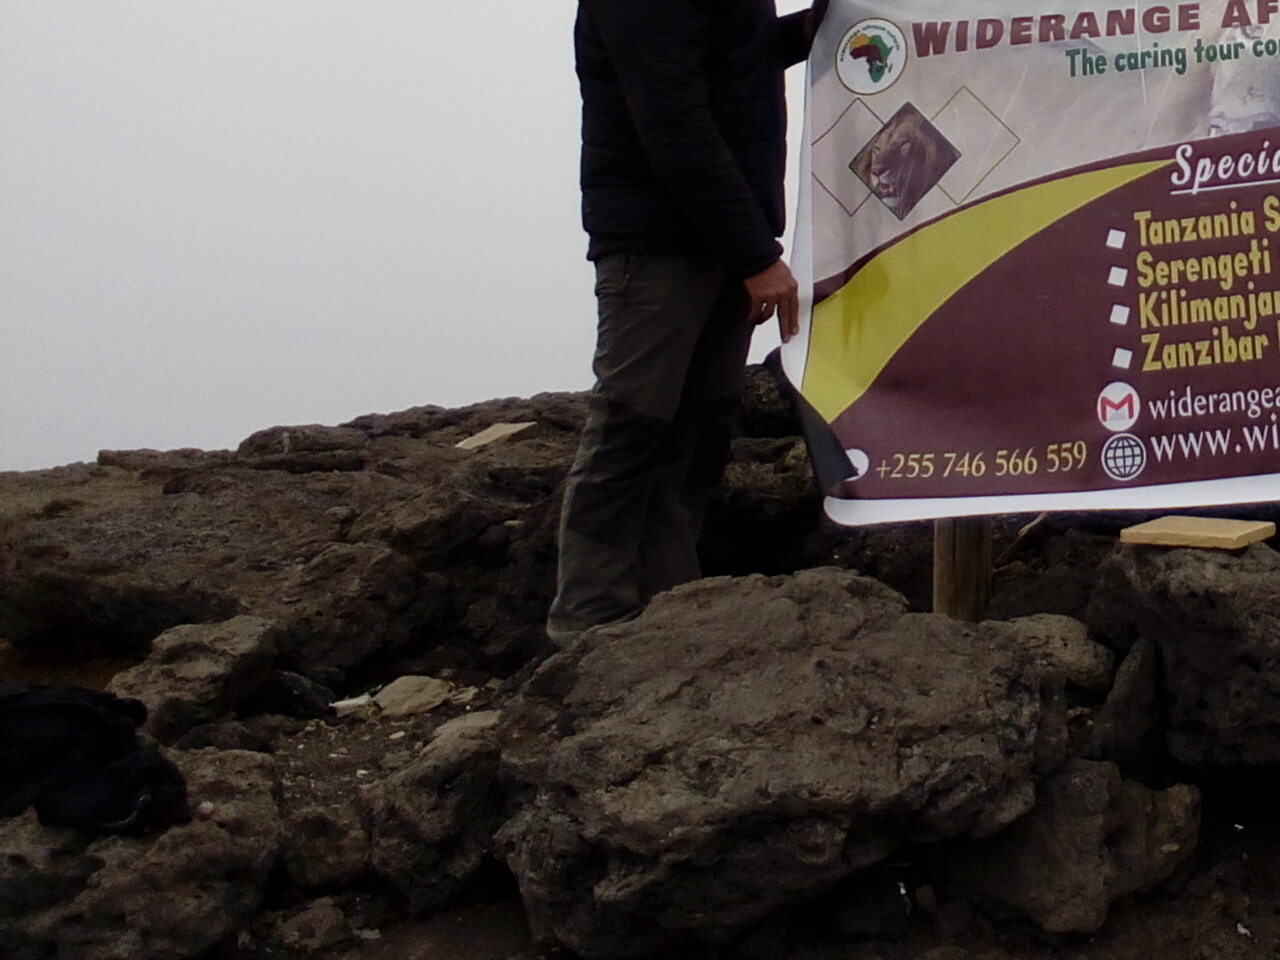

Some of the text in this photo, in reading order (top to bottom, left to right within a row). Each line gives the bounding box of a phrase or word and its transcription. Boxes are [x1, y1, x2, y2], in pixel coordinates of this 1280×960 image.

[912, 3, 1201, 58] WIDERANGE
[1065, 48, 1107, 77] The
[1115, 42, 1186, 74] caring
[1194, 39, 1244, 63] tour
[1134, 201, 1255, 246] Tanzania
[1137, 238, 1271, 290] Serengeti
[1141, 326, 1268, 371] Zanzibar
[876, 441, 1087, 479] +255 746 566 559
